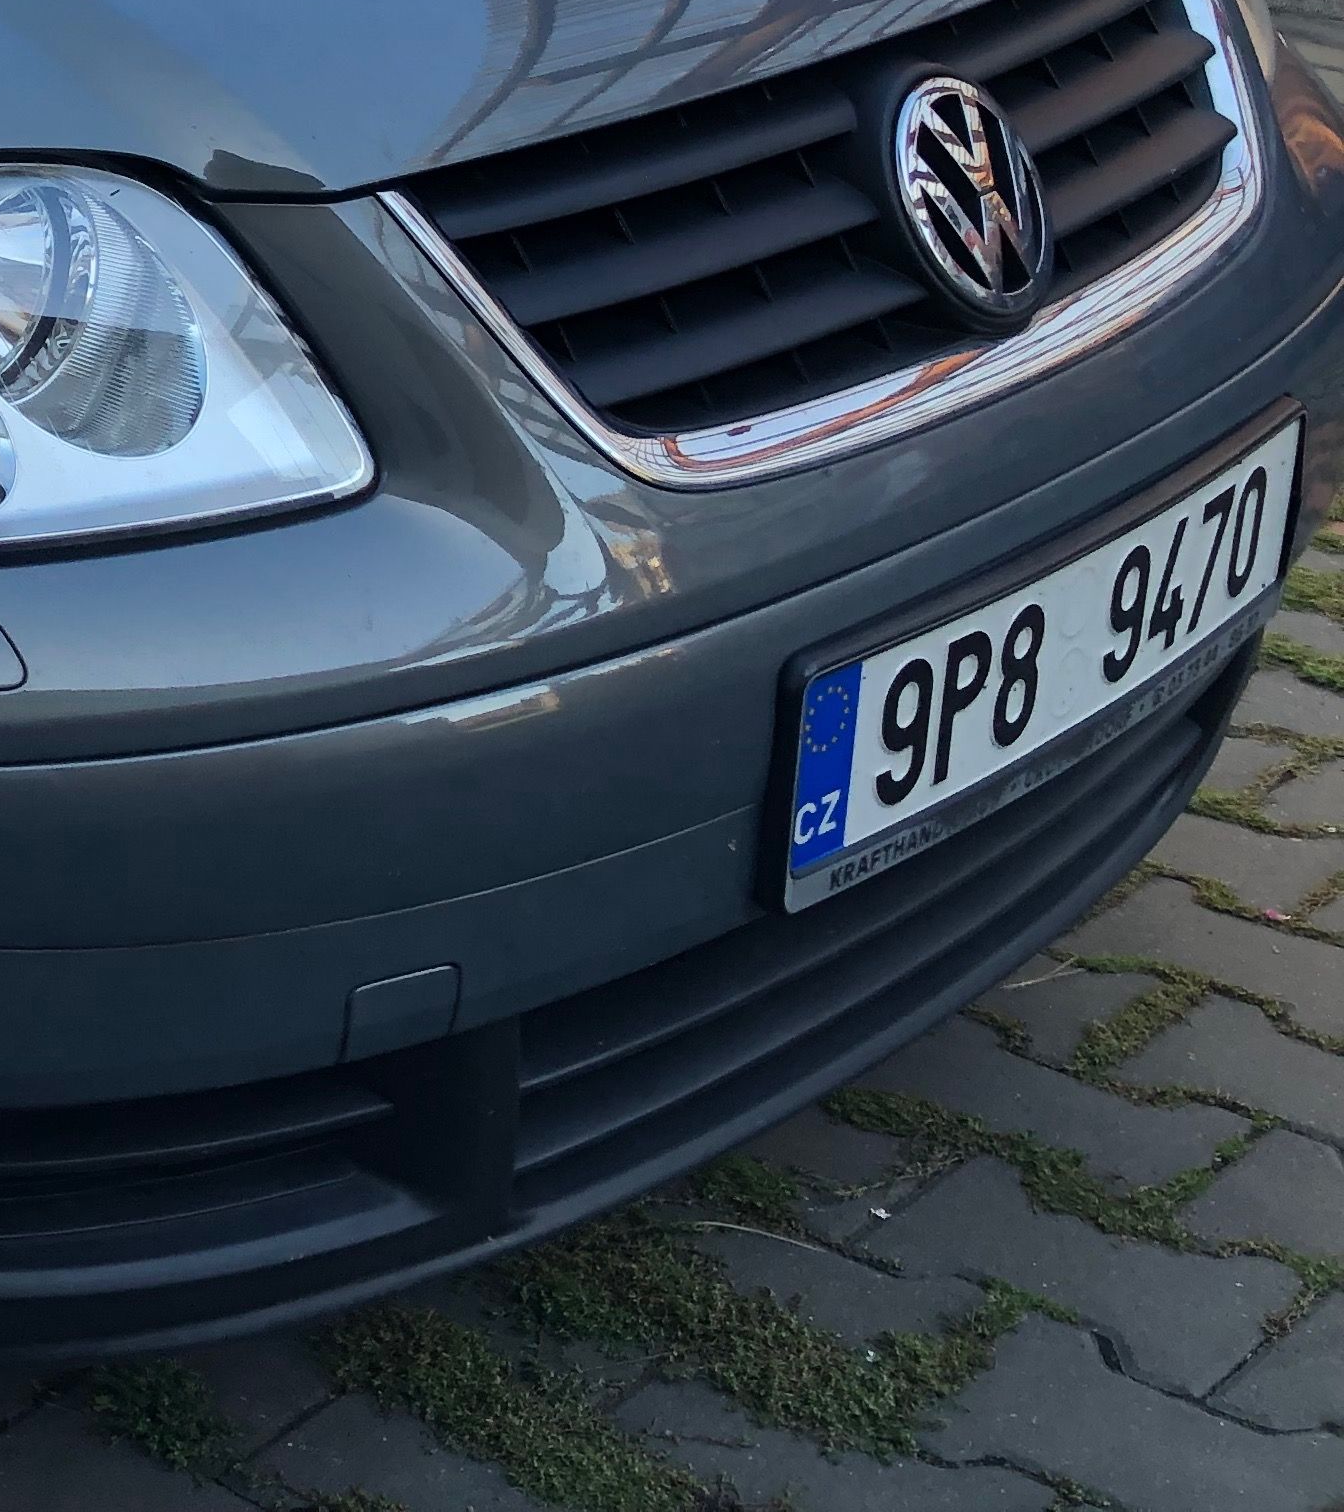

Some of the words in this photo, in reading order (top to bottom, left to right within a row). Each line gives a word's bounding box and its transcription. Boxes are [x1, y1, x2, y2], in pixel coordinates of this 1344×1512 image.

[897, 76, 1047, 309] VW
[875, 602, 1046, 806] 9P8
[1102, 465, 1267, 684] 9470
[794, 790, 837, 846] CZ
